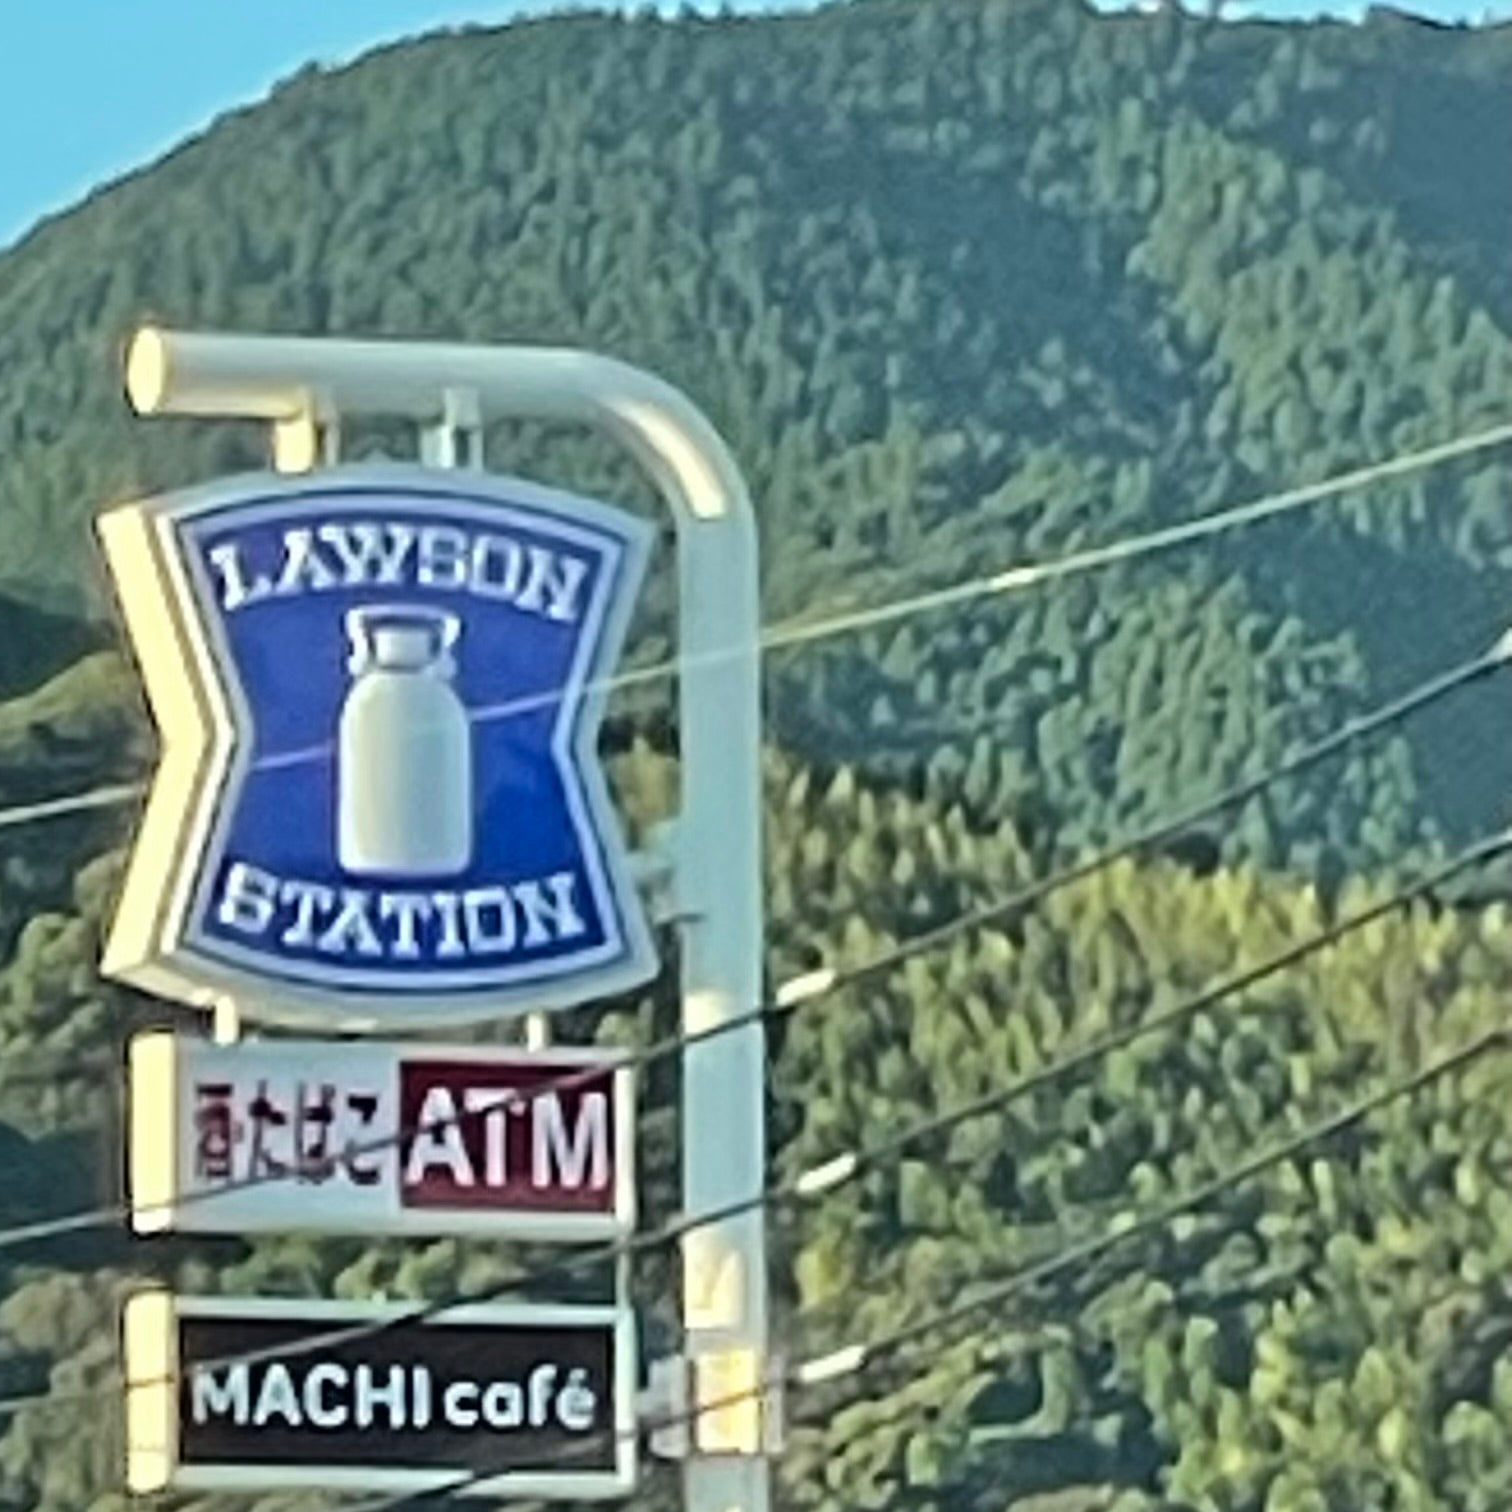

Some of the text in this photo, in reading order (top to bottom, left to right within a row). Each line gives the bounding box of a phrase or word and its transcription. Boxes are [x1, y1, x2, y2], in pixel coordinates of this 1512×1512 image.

[211, 524, 584, 621] LAWSON
[220, 862, 585, 958] STATION
[406, 1086, 609, 1189] ATM
[193, 1363, 597, 1430] MACHI café
